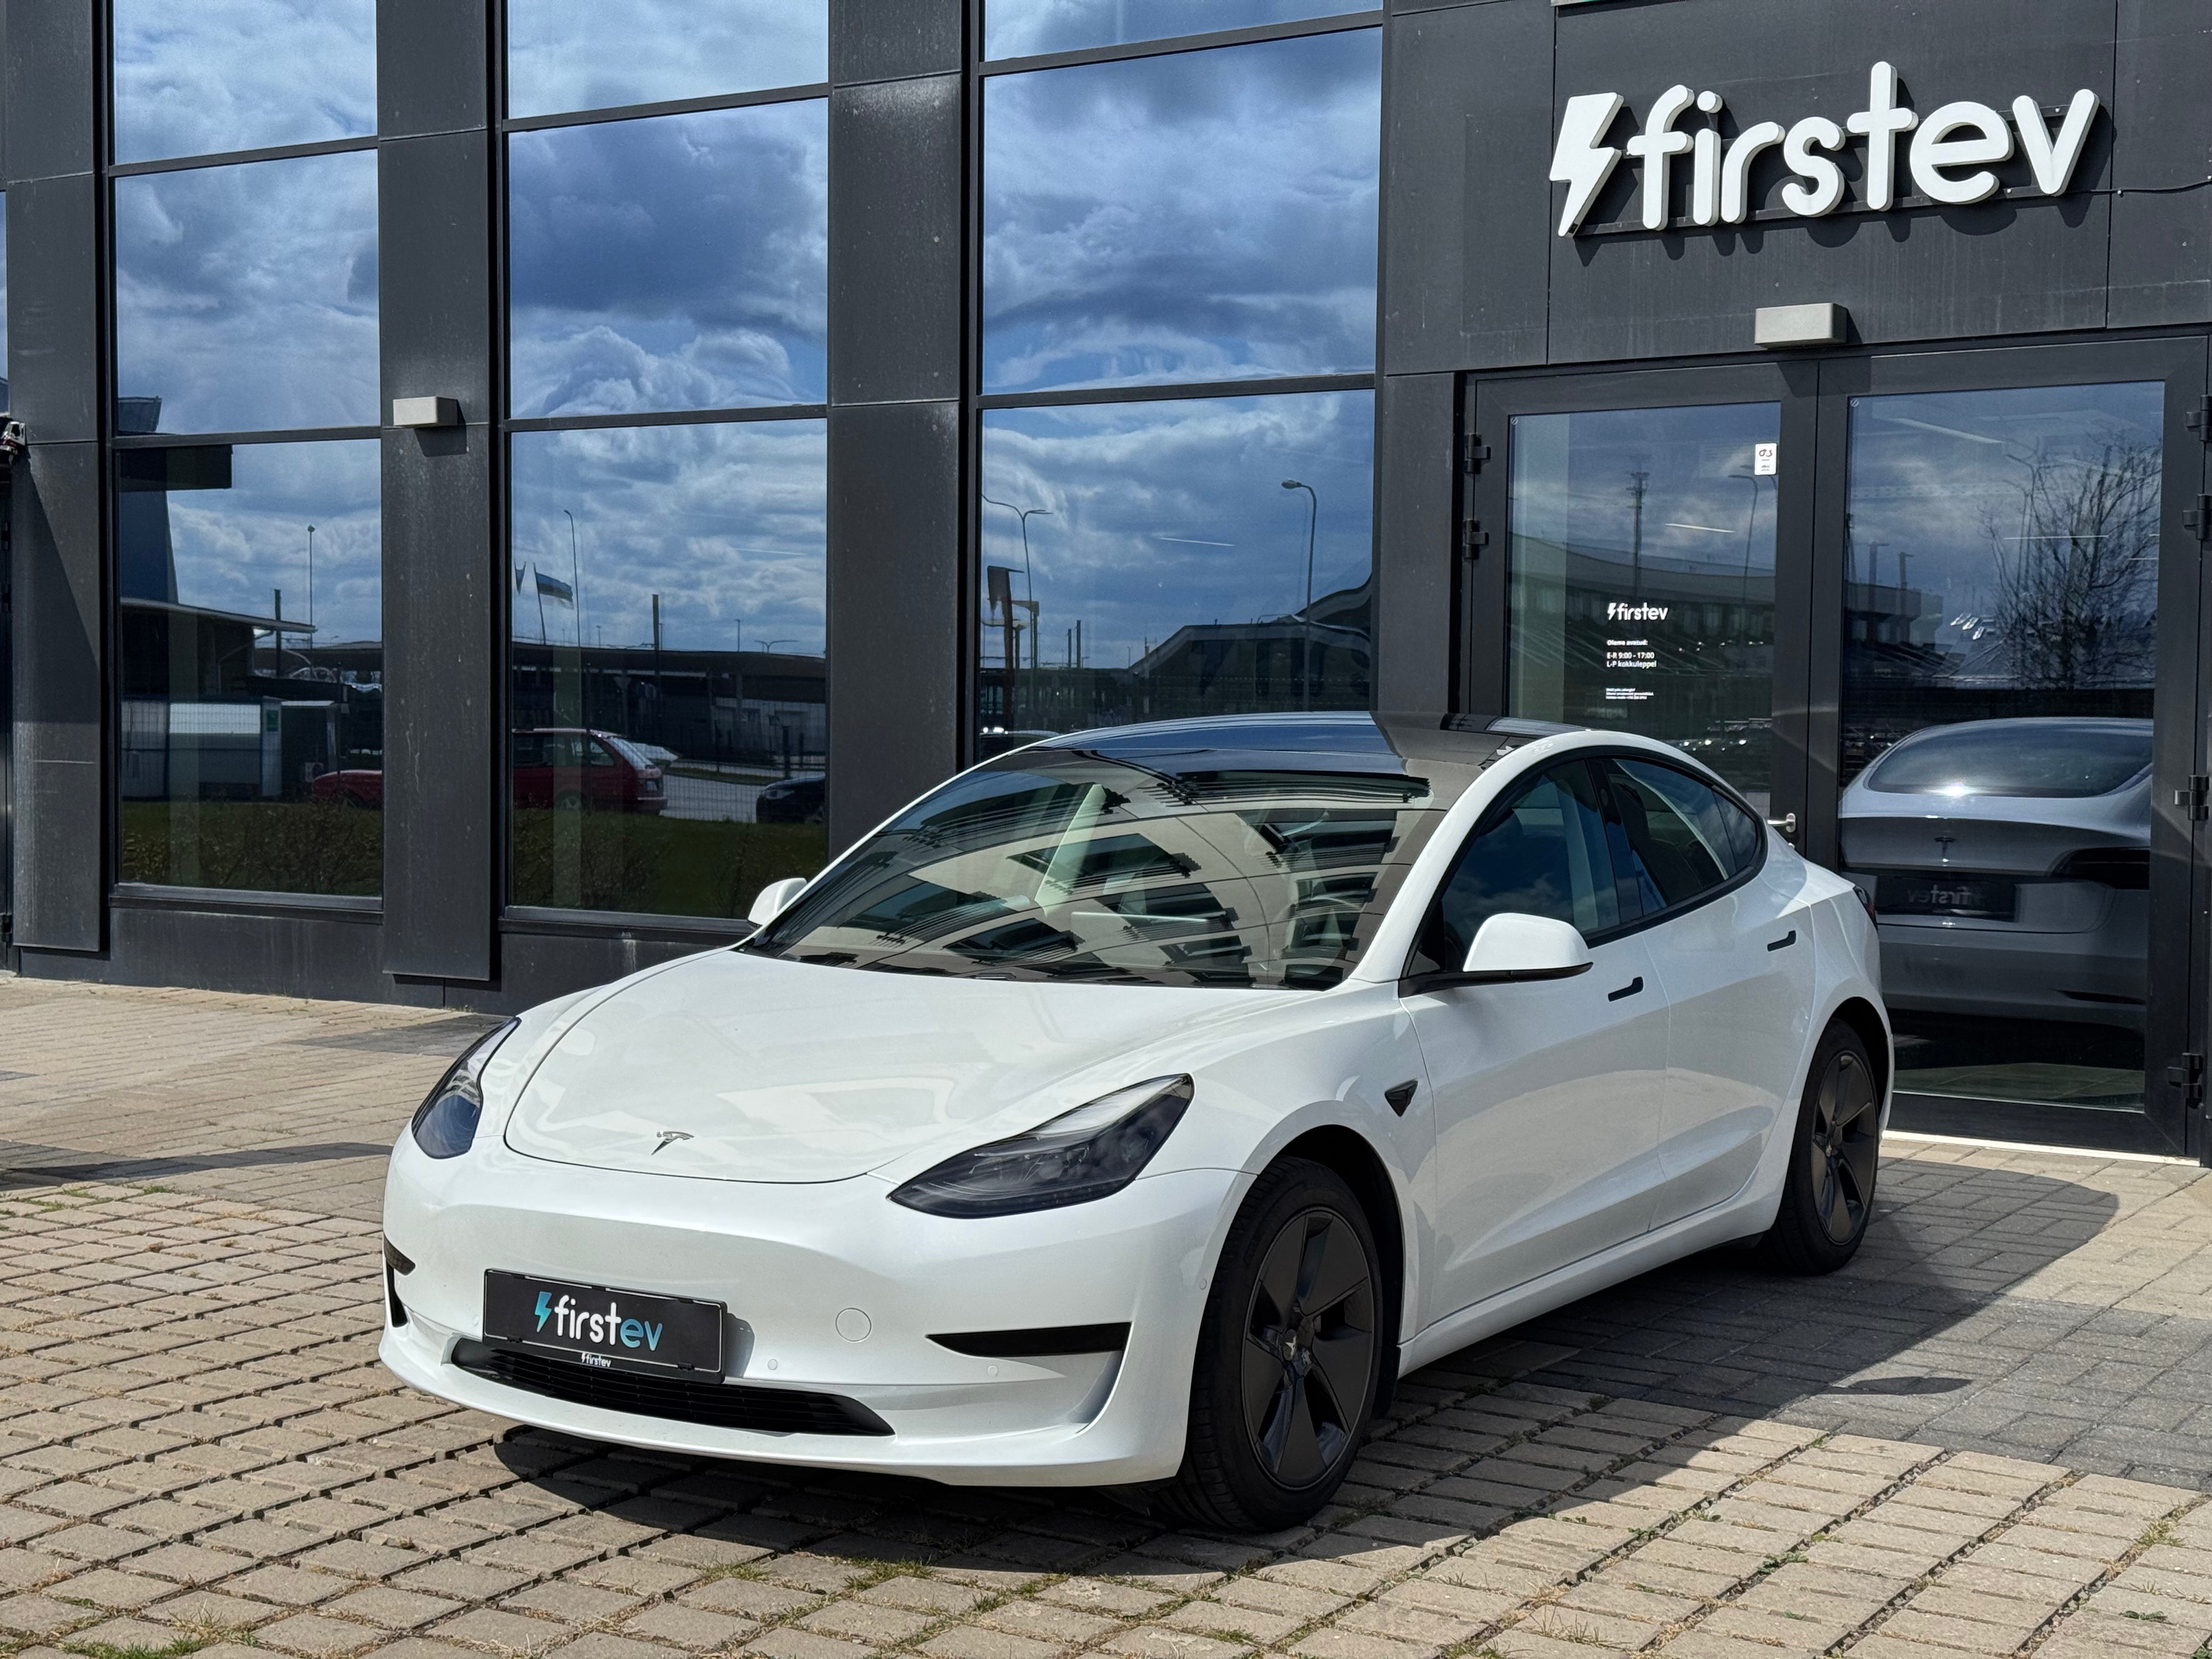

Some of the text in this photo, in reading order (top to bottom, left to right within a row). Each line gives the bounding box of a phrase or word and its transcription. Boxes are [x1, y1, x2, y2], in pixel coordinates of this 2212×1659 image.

[1627, 61, 2100, 230] firstev
[1617, 602, 1668, 620] firstev
[1618, 661, 1657, 669] kokkuleppel
[554, 1295, 663, 1351] firstev
[585, 1353, 612, 1368] firstev
